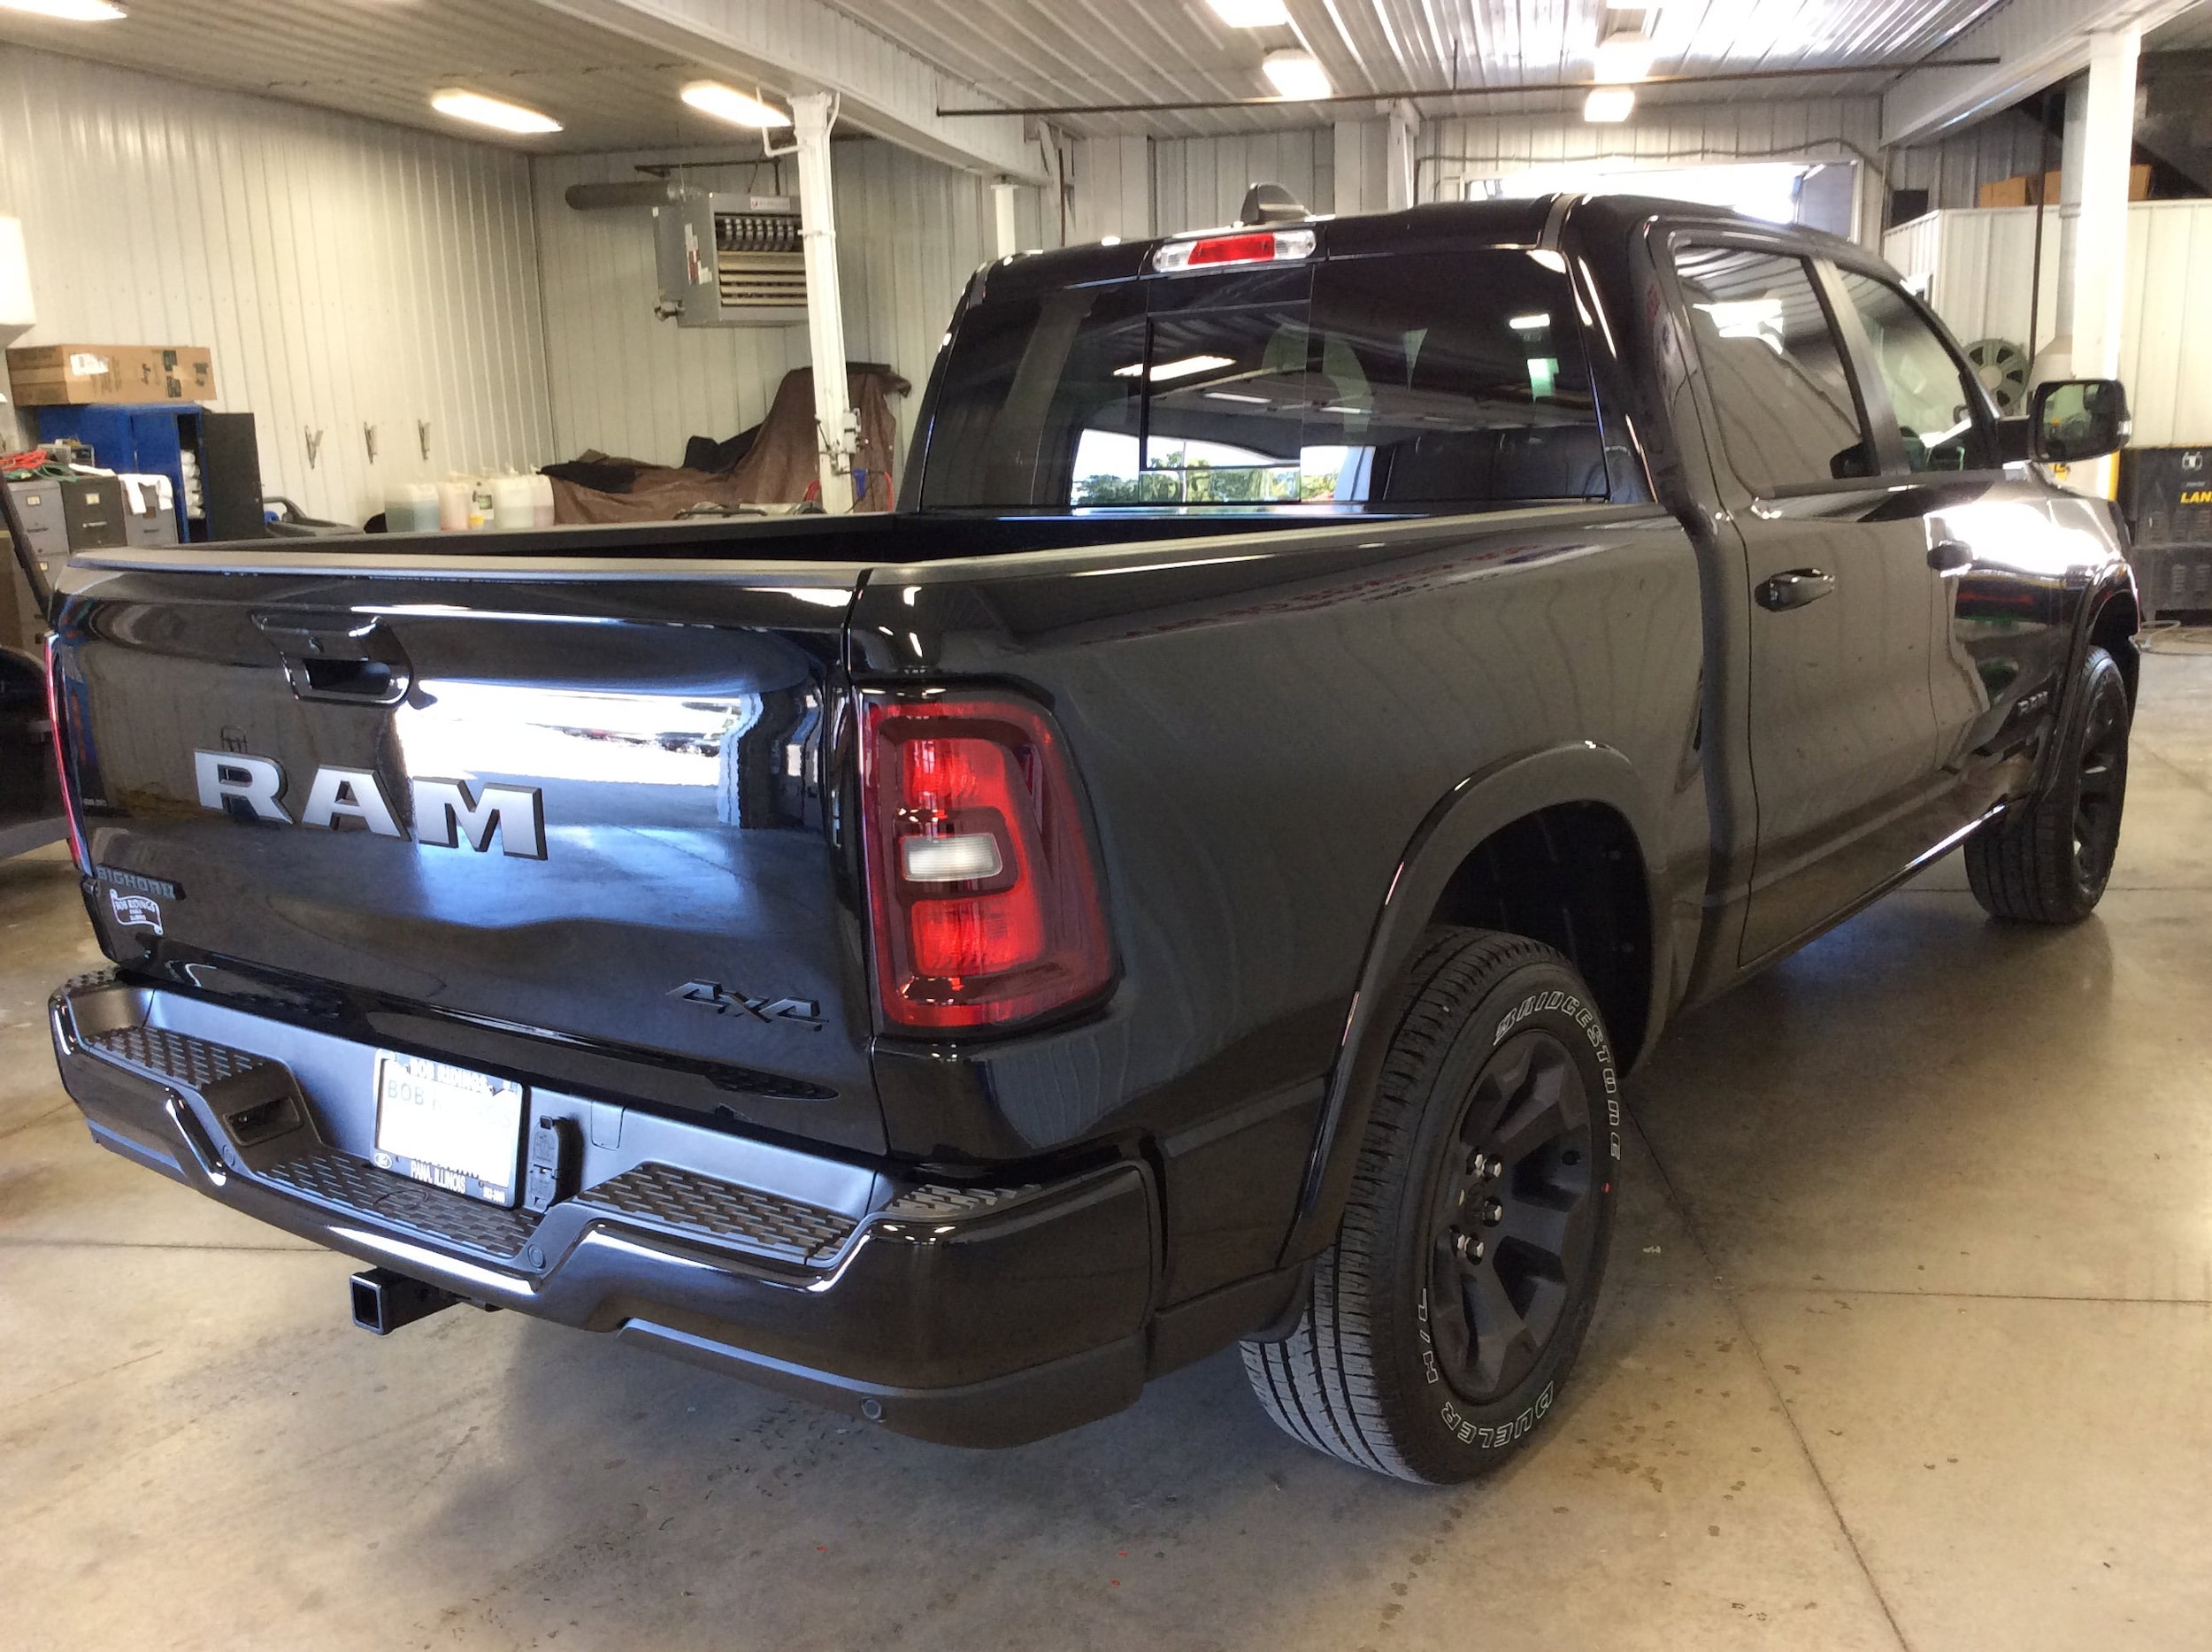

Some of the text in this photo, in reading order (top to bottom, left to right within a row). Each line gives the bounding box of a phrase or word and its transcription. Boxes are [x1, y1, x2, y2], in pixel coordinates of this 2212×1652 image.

[2180, 491, 2212, 504] LAN
[194, 749, 548, 861] RAM
[388, 1079, 425, 1105] BOB
[1494, 990, 1621, 1161] BRIDGESTONE
[434, 1167, 466, 1195] ILLINOIS
[1441, 1381, 1554, 1448] DUELER
